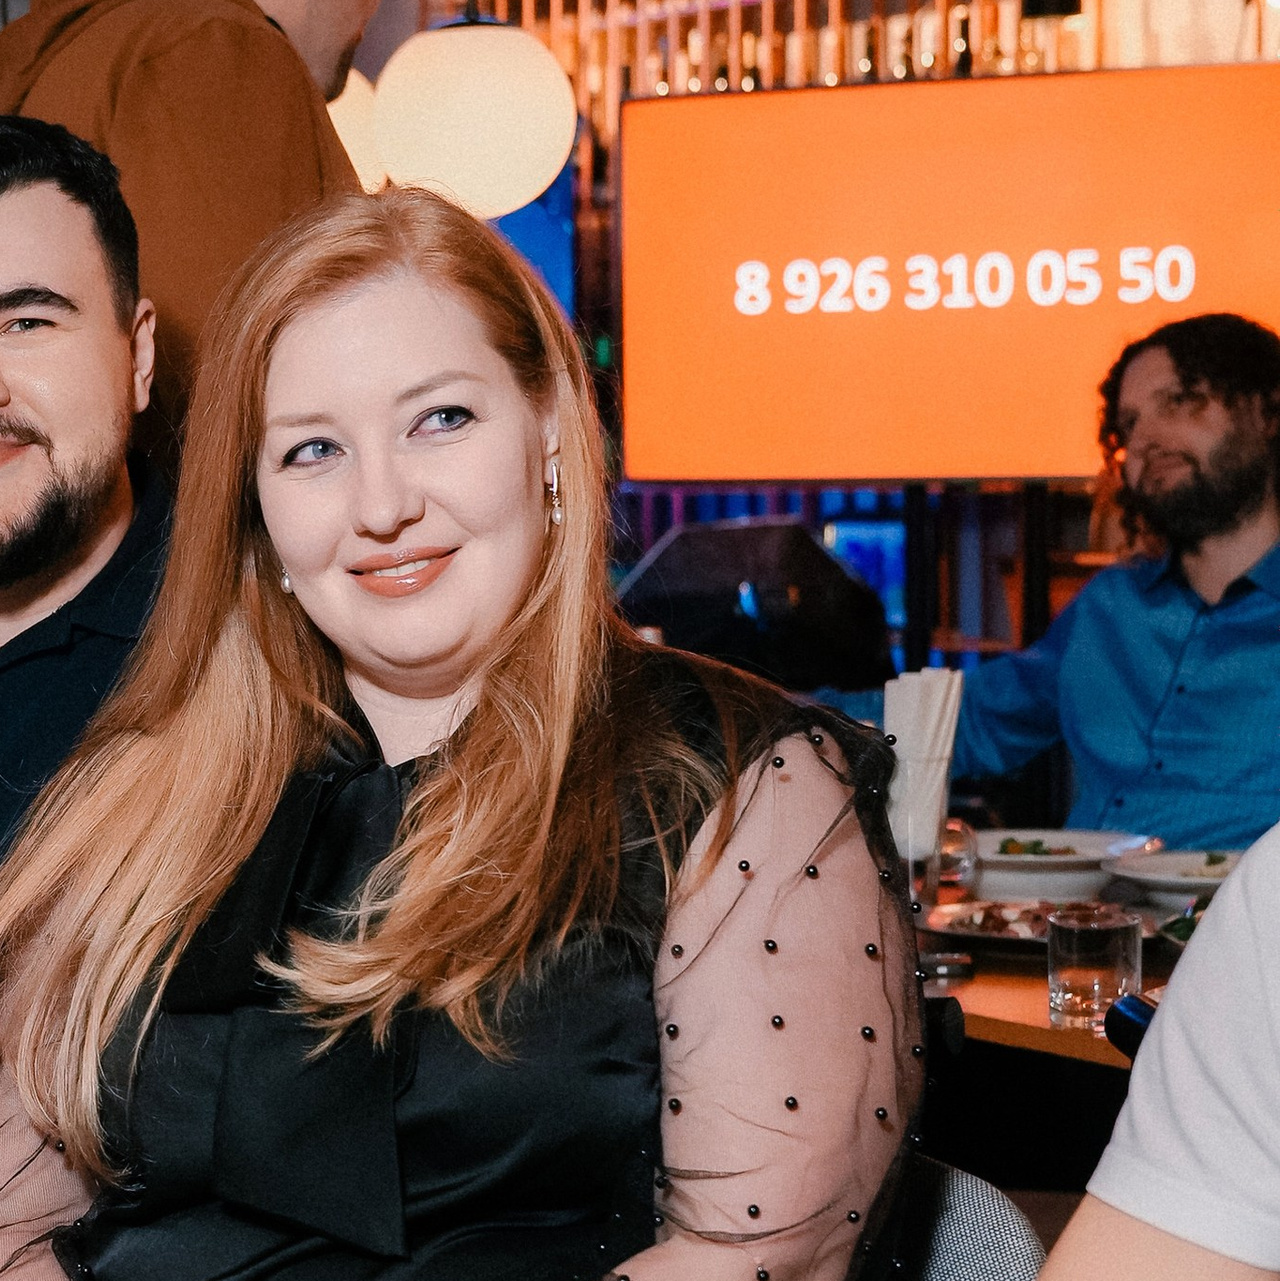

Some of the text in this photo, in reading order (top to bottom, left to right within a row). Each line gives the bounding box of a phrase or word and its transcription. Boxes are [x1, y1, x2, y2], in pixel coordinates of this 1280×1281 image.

[733, 246, 1196, 316] 8 926 310 05 50
